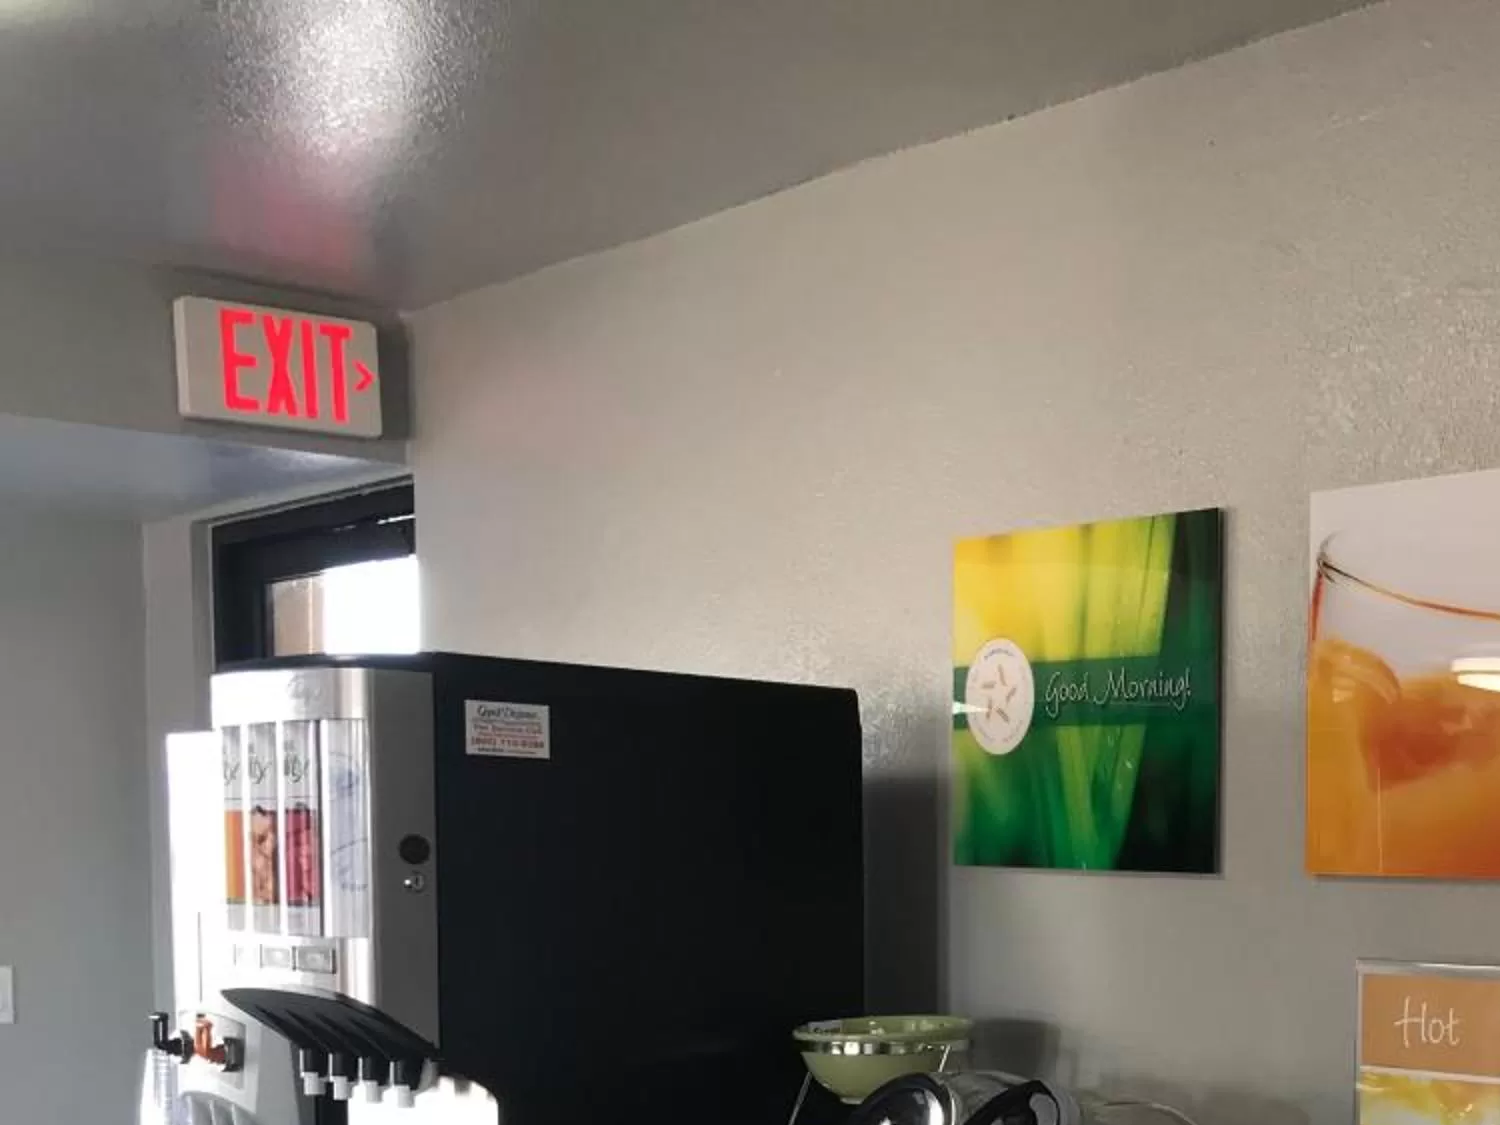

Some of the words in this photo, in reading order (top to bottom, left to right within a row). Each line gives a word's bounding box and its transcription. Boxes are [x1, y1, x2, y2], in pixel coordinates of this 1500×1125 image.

[220, 308, 352, 424] EXIT
[1045, 671, 1089, 718] Good
[1093, 666, 1192, 711] Morning!
[1393, 995, 1461, 1048] Hot
